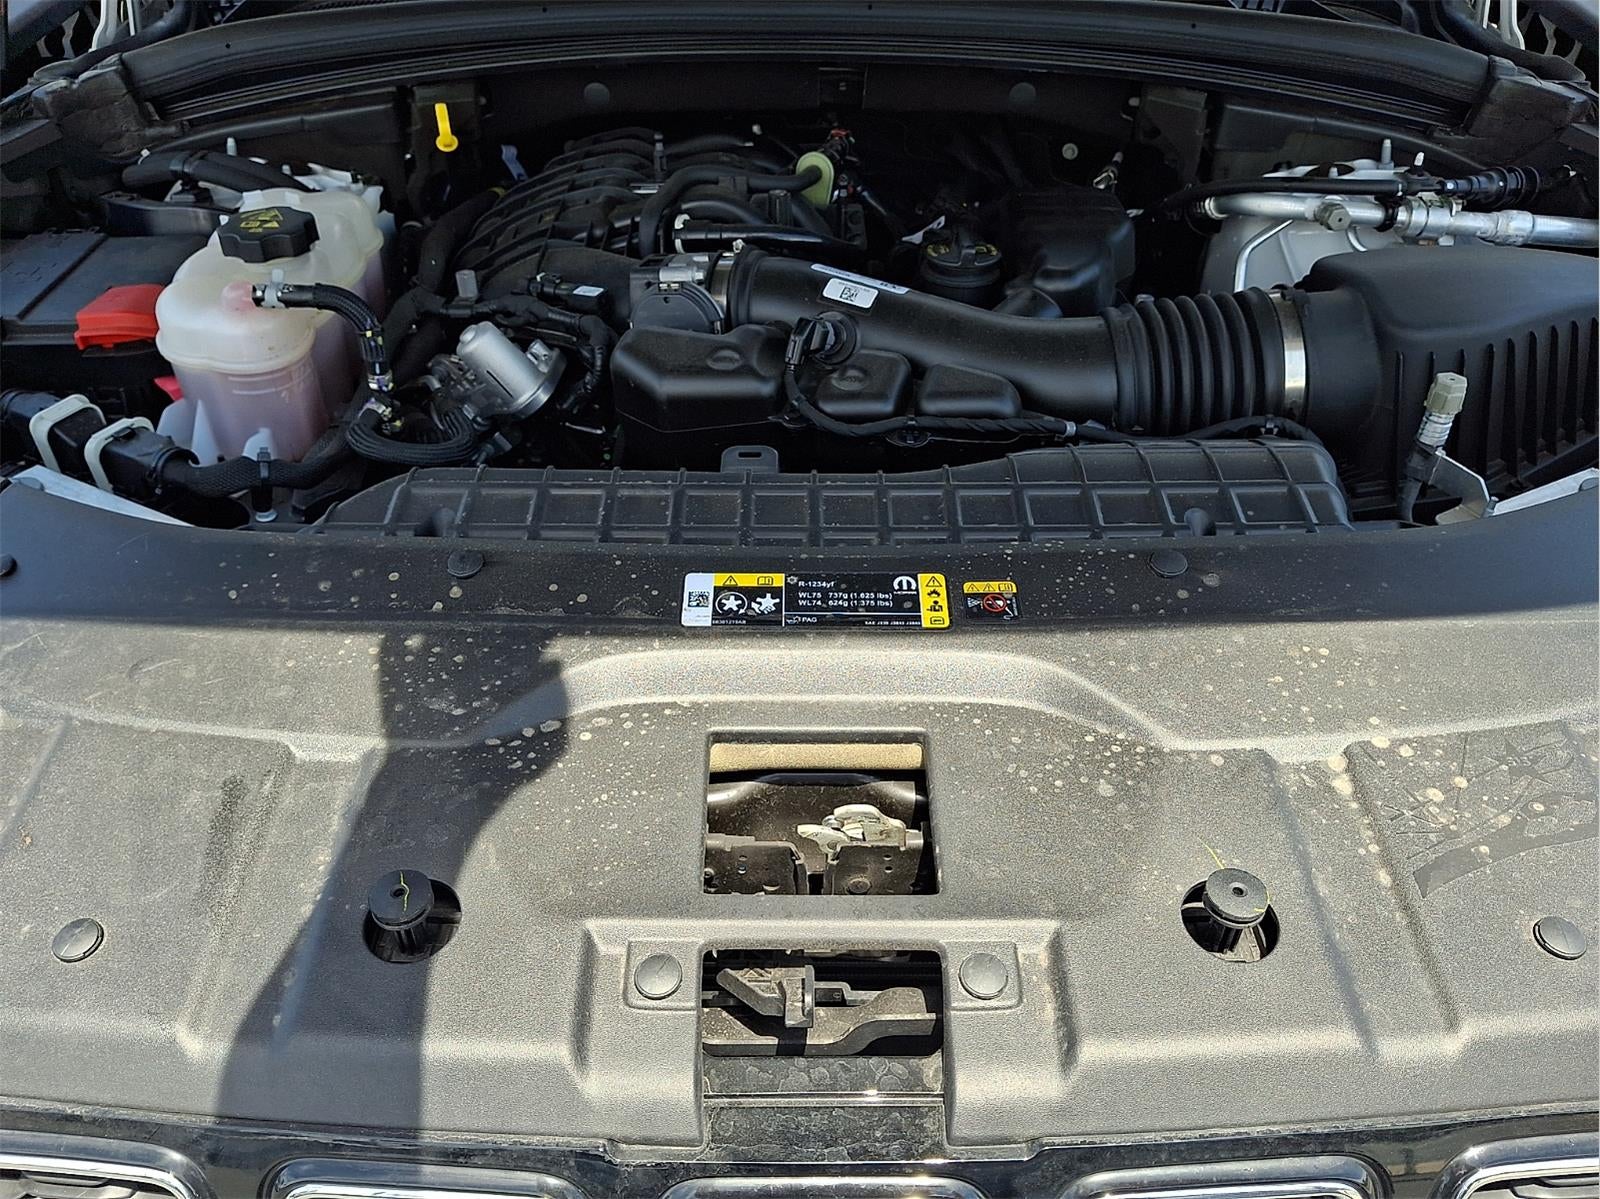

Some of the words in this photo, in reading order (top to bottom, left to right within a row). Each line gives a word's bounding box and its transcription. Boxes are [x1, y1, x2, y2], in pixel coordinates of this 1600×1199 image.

[798, 580, 835, 589] R-1234yf
[828, 592, 848, 600] 737g
[850, 592, 875, 600] (1.625
[876, 592, 893, 600] lbs)
[828, 600, 848, 608] 624g
[850, 600, 875, 608] (1.375
[876, 600, 893, 608] lbs)
